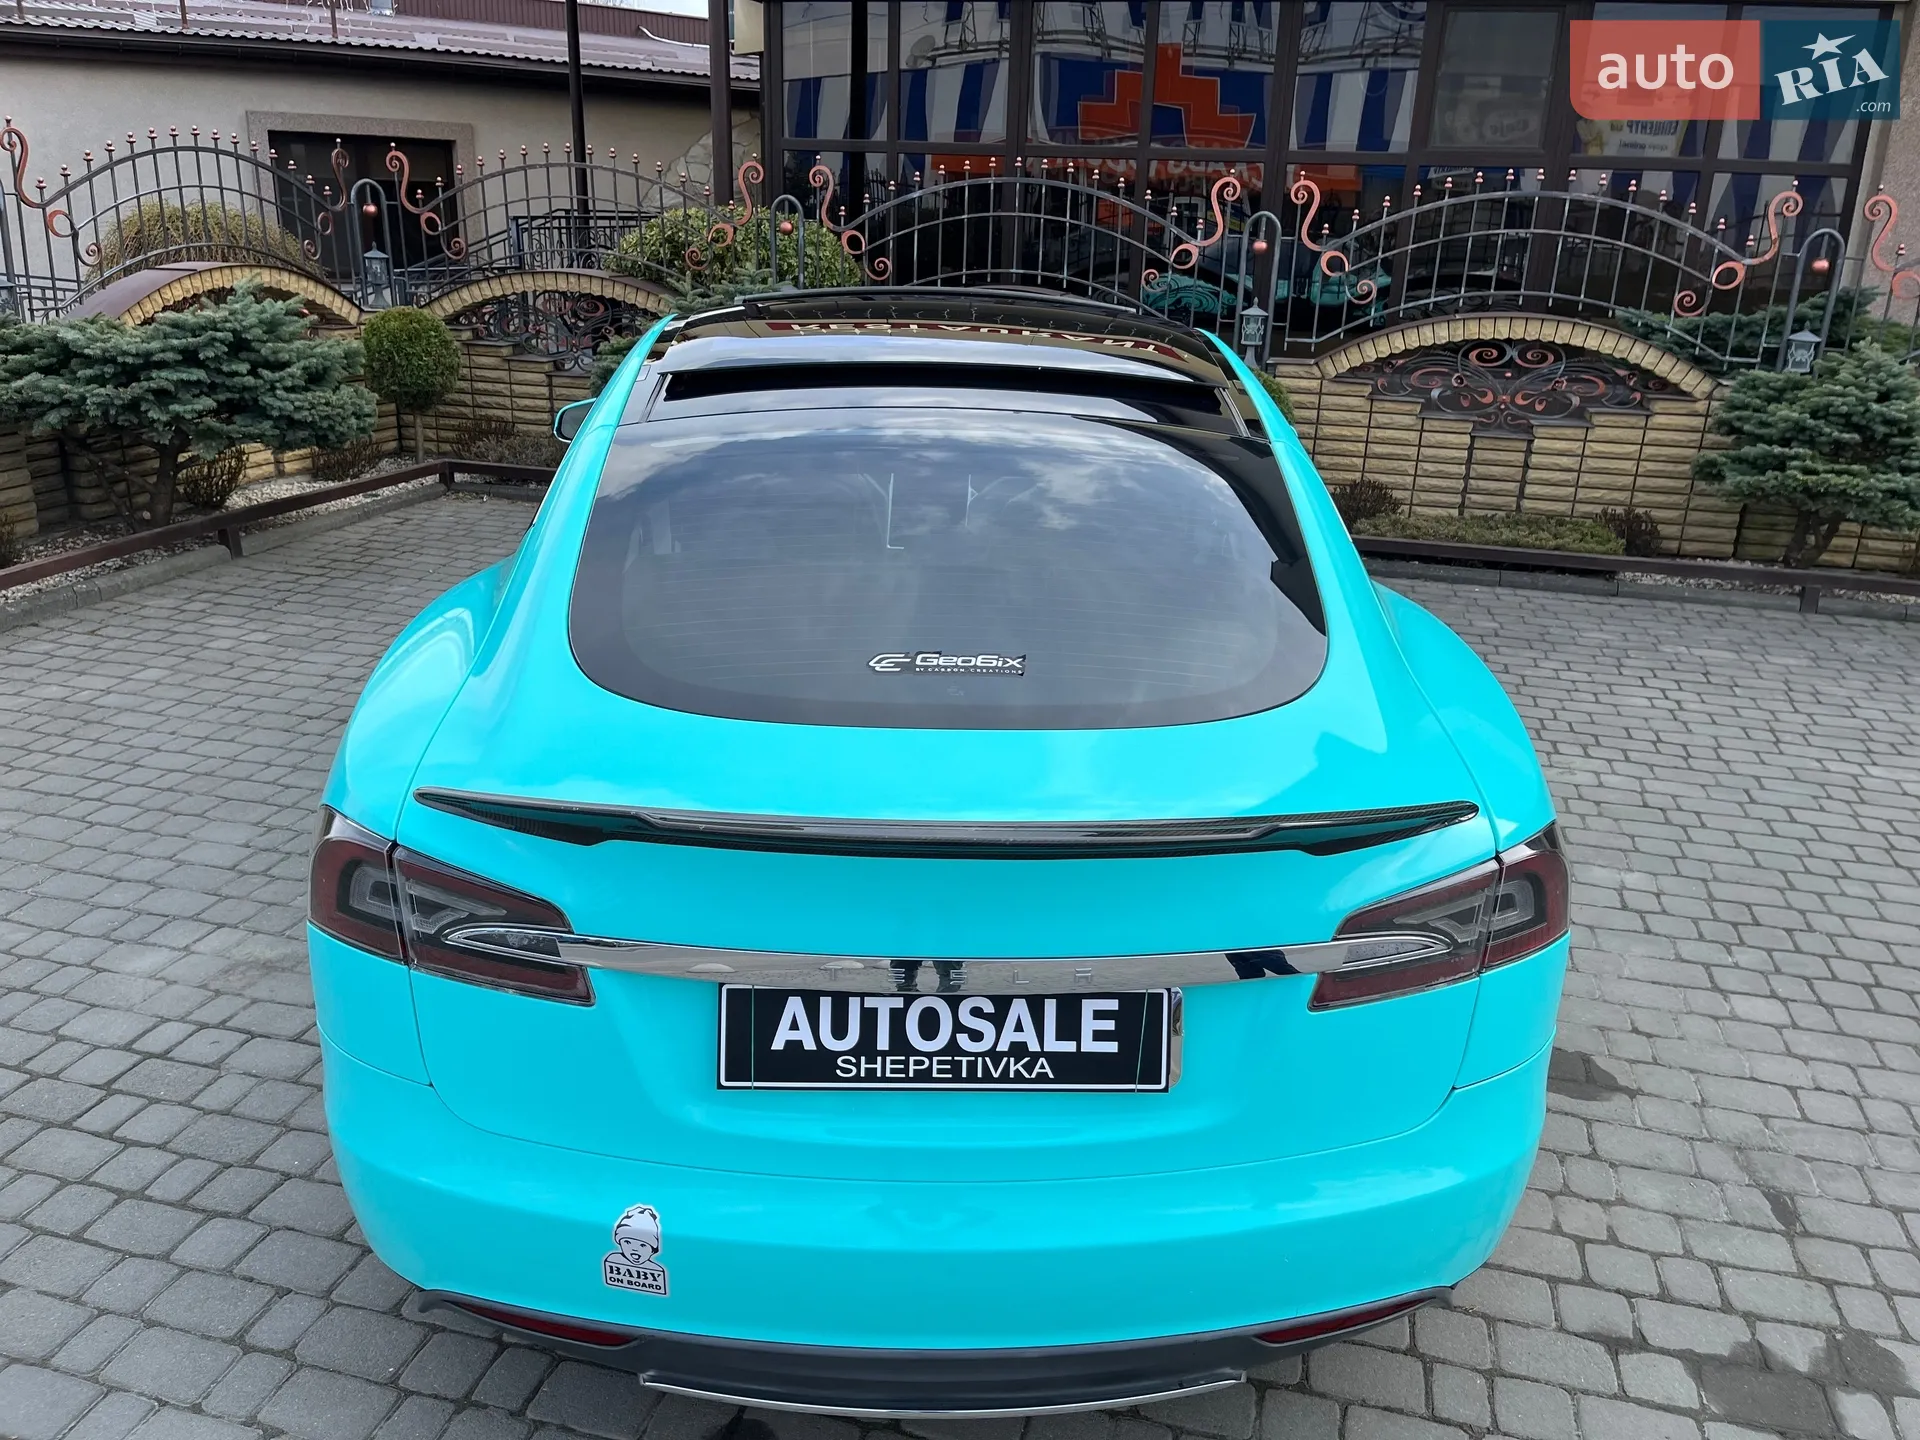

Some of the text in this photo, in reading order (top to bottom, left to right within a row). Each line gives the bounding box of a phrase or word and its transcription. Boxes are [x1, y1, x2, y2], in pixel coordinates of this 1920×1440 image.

[915, 654, 1023, 668] Geo6ix
[823, 964, 1093, 986] TESLA
[770, 995, 1120, 1053] AUTOSALE
[835, 1055, 1055, 1079] SHEPETIVKA
[609, 1265, 661, 1283] BABY
[609, 1276, 661, 1290] ON BOARD
